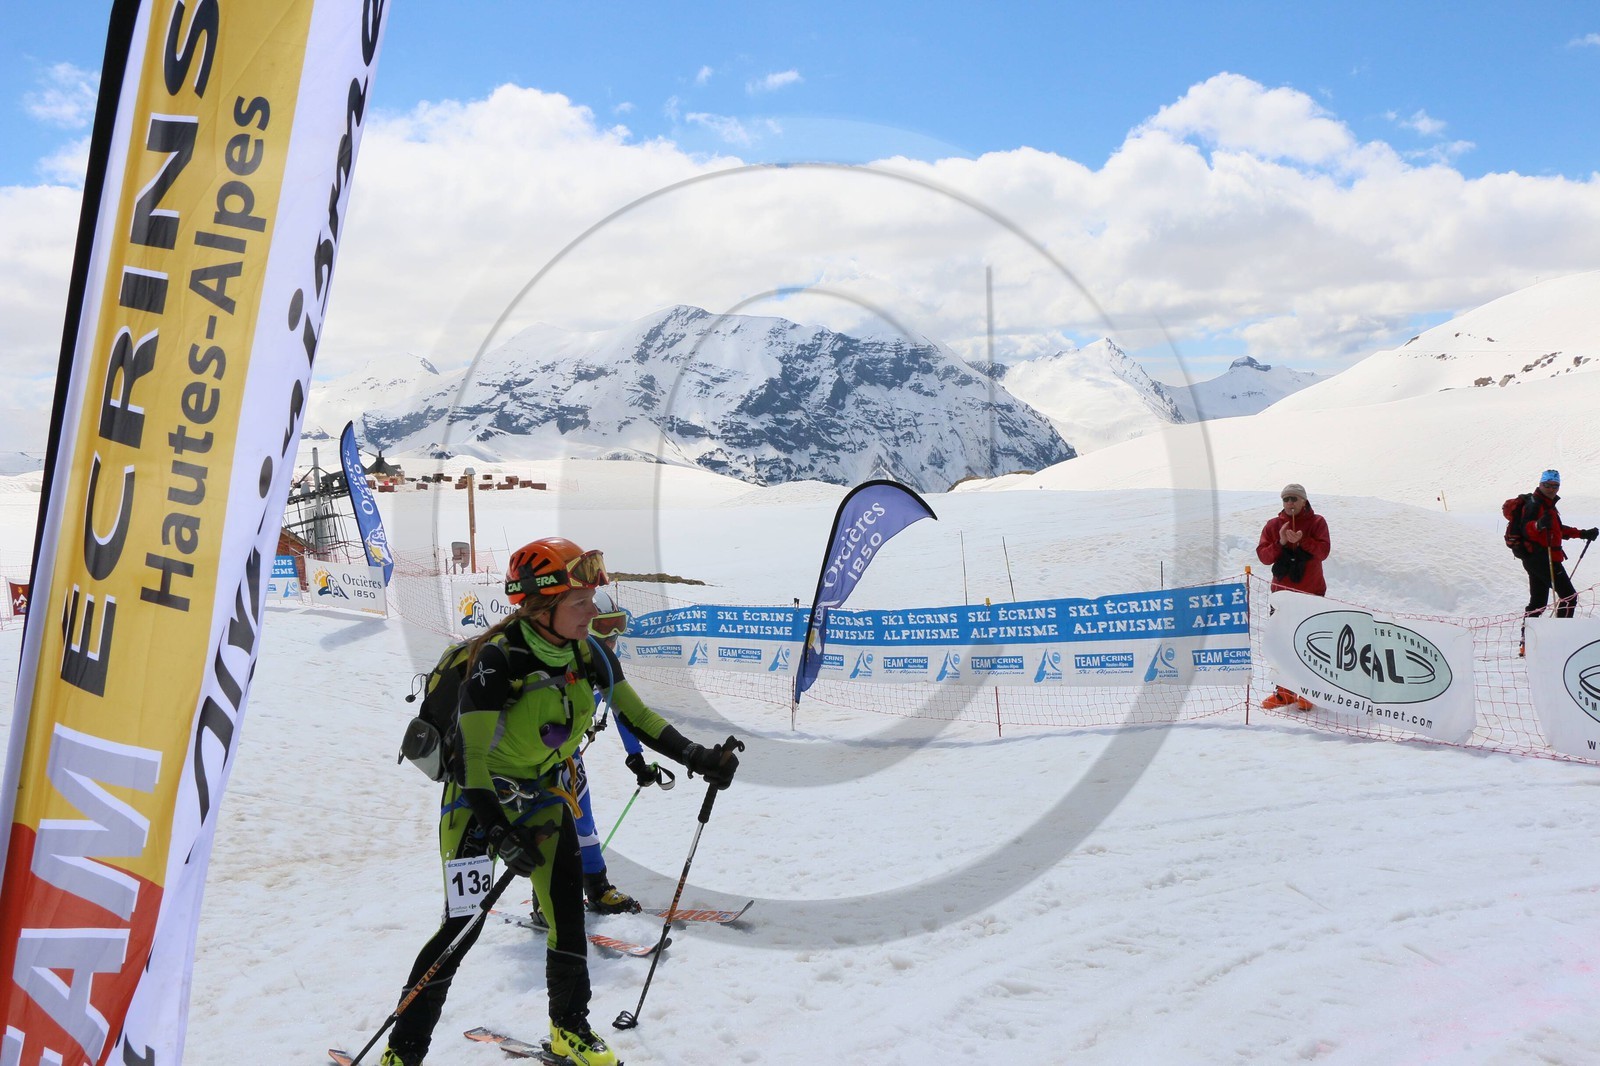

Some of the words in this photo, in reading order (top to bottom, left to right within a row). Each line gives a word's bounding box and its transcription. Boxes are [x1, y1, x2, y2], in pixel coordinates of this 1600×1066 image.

[60, 0, 221, 698] ÉCRINS
[139, 95, 271, 611] Hautes-Alpes
[823, 501, 886, 588] Orcières
[847, 532, 882, 581] 1850
[342, 573, 382, 590] Orcières
[353, 590, 376, 599] 1850
[1188, 593, 1224, 609] SKI
[717, 611, 738, 621] SKI
[743, 609, 794, 623] ÉCRINS
[968, 610, 991, 623] SKI
[998, 606, 1057, 622] ÉCRINS
[1068, 604, 1100, 618] SKI
[1104, 598, 1174, 615] ÉCRINS
[641, 615, 662, 627] SKI
[881, 614, 905, 626] SKI
[907, 612, 958, 625] ÉCRINS
[1073, 617, 1176, 635] ALPINISME
[718, 623, 793, 636] ALPINISME
[883, 628, 960, 641] ALPINISME
[970, 624, 1059, 639] ALPINISME
[637, 646, 658, 655] TEAM
[1374, 627, 1392, 638] THE
[1397, 632, 1439, 662] DYNAMIC
[719, 648, 738, 658] TEAM
[1074, 656, 1101, 667] TEAM
[1100, 654, 1133, 662] ÉCRINS
[1193, 651, 1223, 664] TEAM
[1336, 623, 1405, 684] BEAL
[883, 658, 904, 668] TEAM
[972, 658, 991, 669] TEAM
[1303, 649, 1339, 681] COMPANY
[452, 870, 491, 896] 13a
[0, 722, 162, 1066] AM
